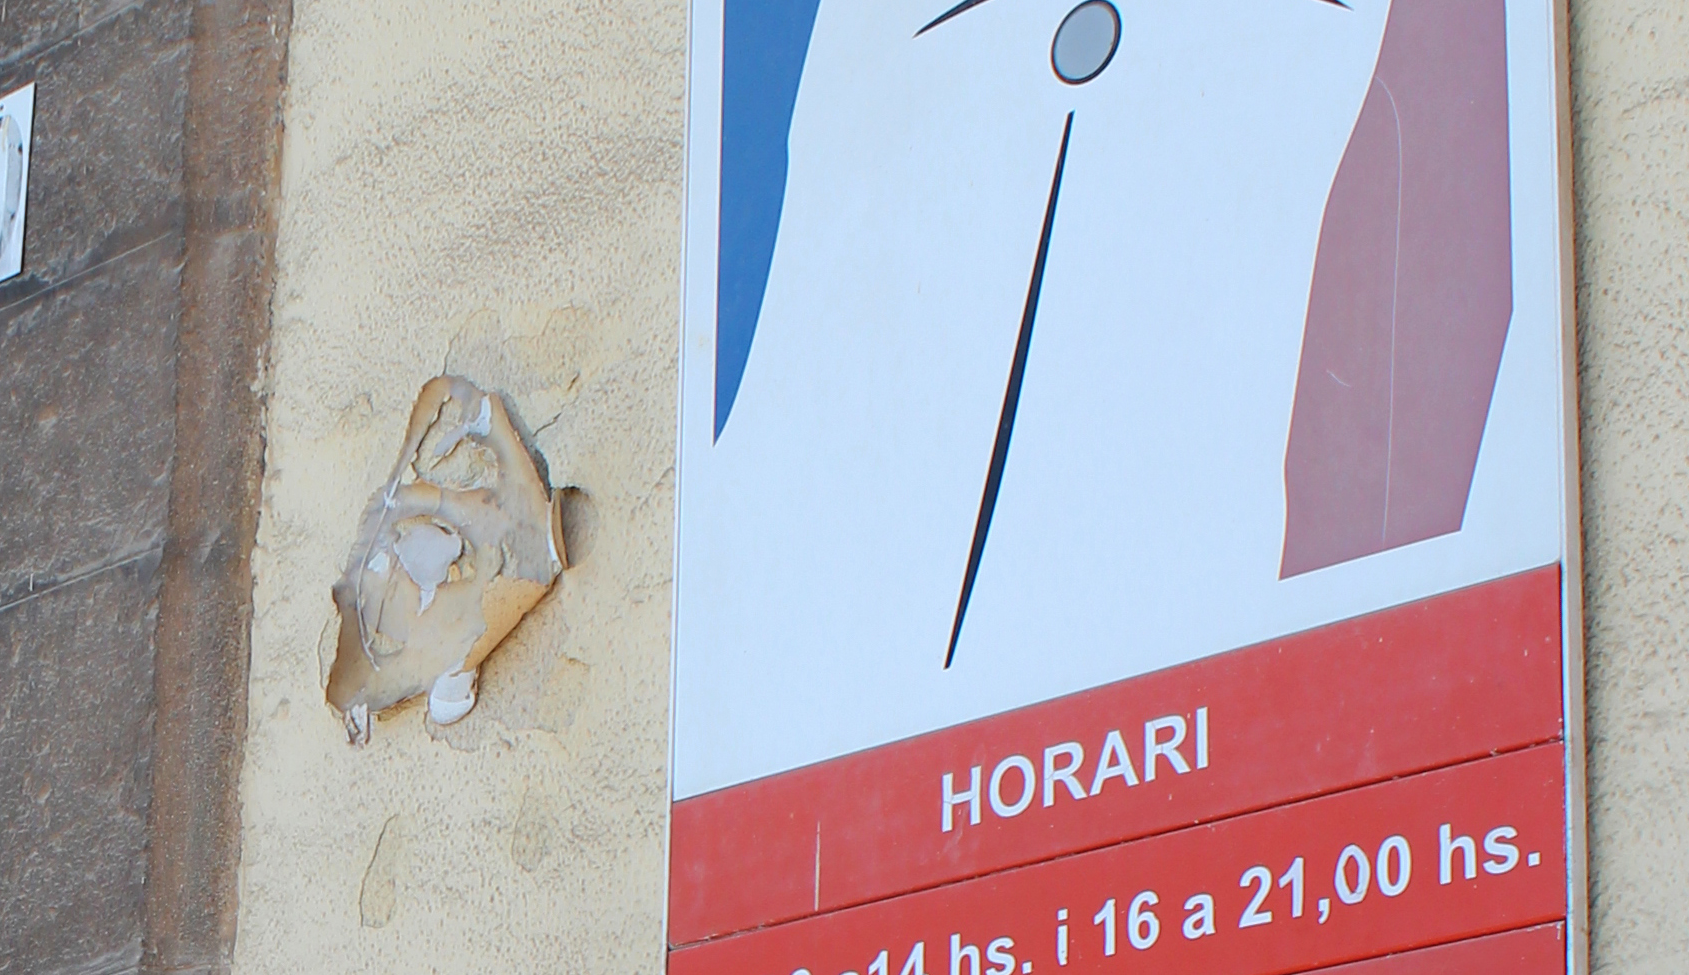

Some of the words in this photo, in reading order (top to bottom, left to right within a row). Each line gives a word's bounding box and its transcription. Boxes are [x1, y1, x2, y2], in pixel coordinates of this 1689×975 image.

[940, 705, 1210, 834] HORARI
[1056, 907, 1070, 967] i
[1092, 889, 1161, 957] 16
[1181, 892, 1217, 941] a
[1237, 834, 1413, 929] 21,00
[1438, 822, 1542, 886] hs.
